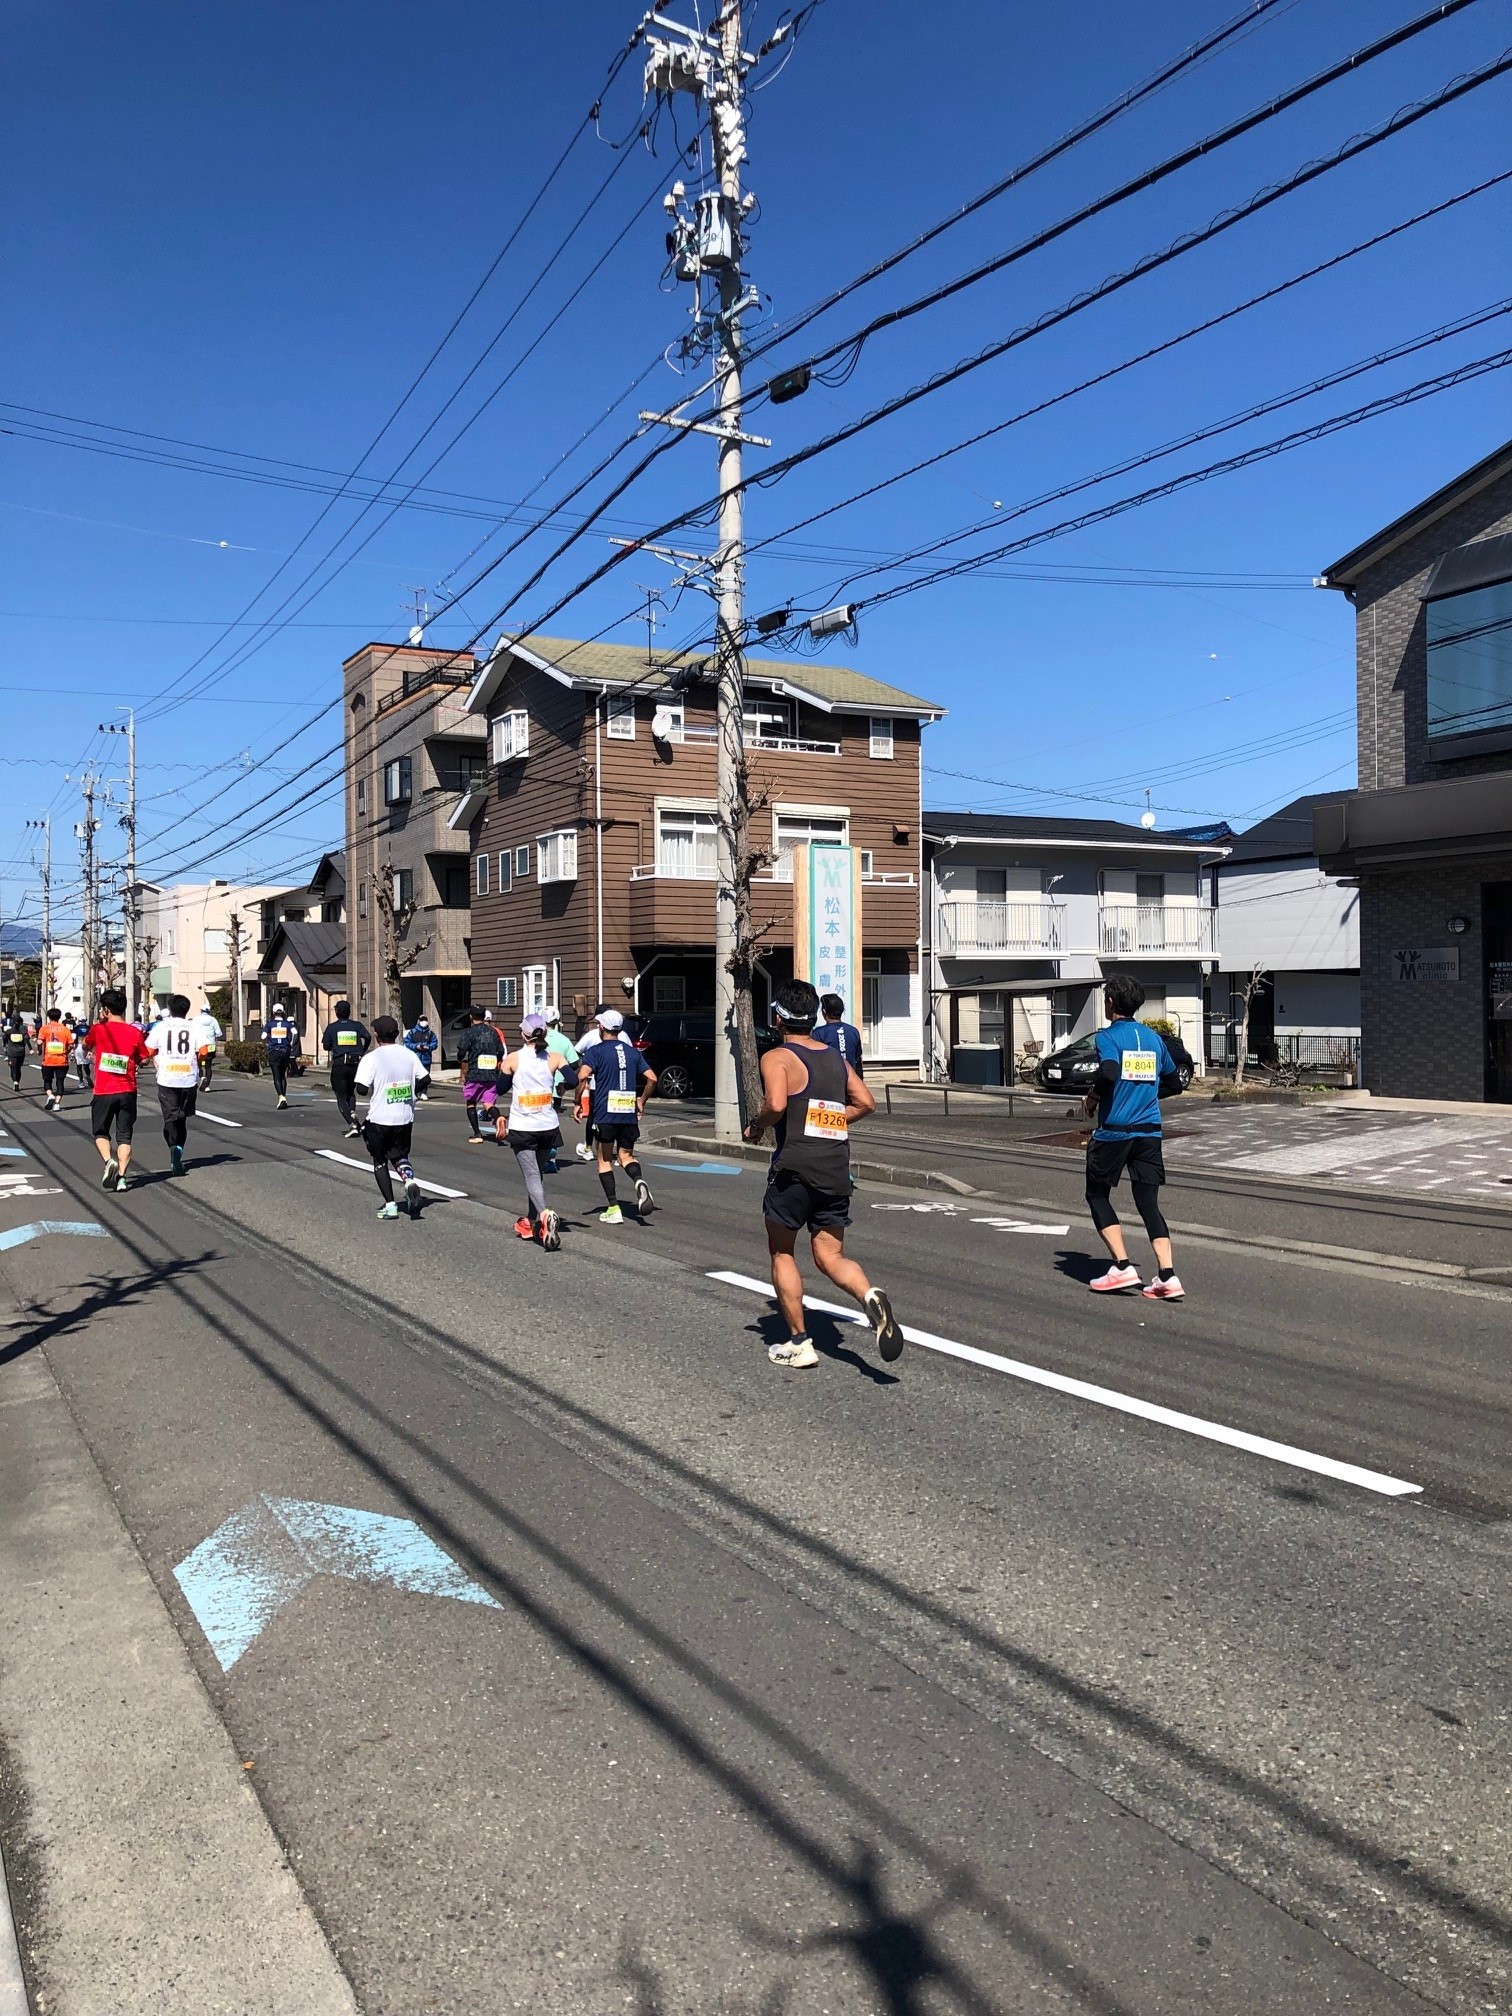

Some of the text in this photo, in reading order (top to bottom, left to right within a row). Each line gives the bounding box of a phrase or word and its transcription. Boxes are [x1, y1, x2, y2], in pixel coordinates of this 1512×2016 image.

[824, 896, 840, 938] 松本
[834, 945, 847, 1014] 整形外
[166, 1029, 190, 1055] 18
[1134, 1061, 1155, 1070] 8041
